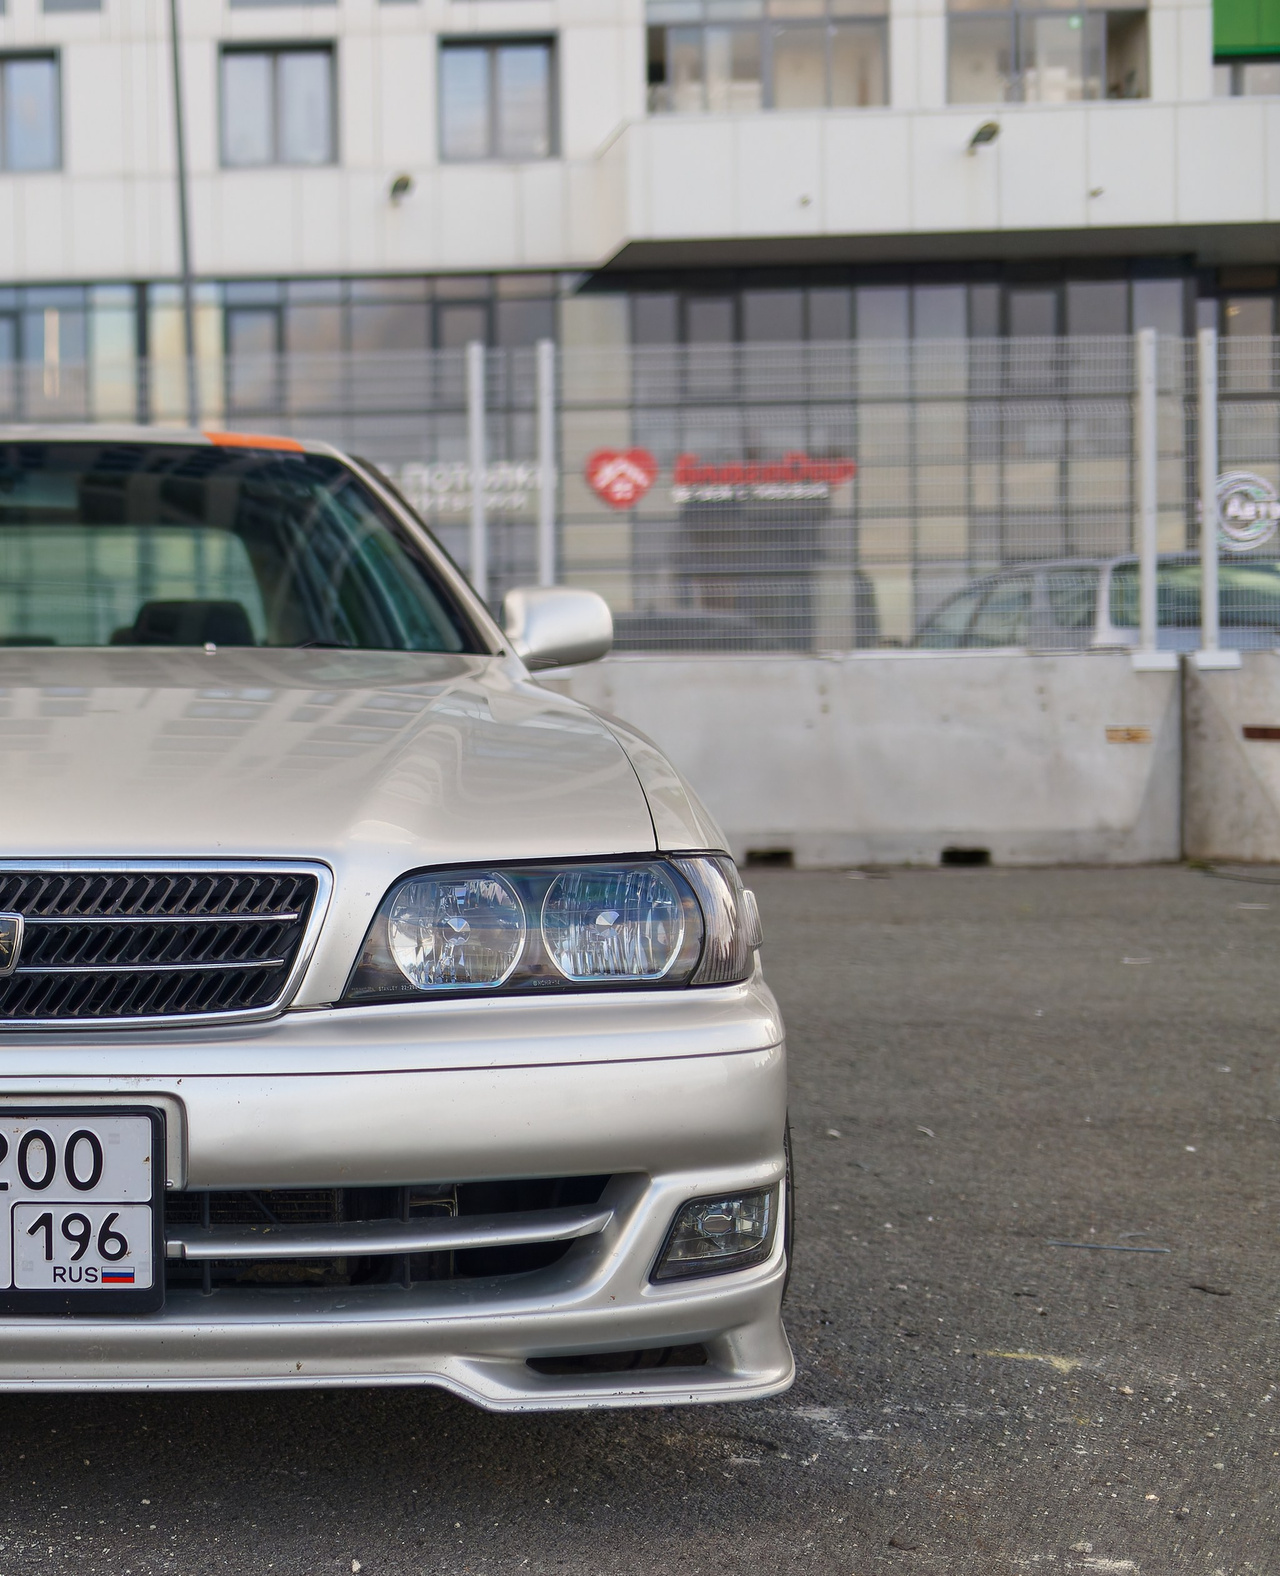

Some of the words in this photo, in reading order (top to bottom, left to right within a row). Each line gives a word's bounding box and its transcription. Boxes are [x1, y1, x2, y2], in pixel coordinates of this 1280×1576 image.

[402, 462, 558, 492] ПОТЛК
[27, 1212, 129, 1262] 196
[53, 1266, 98, 1283] RUS
